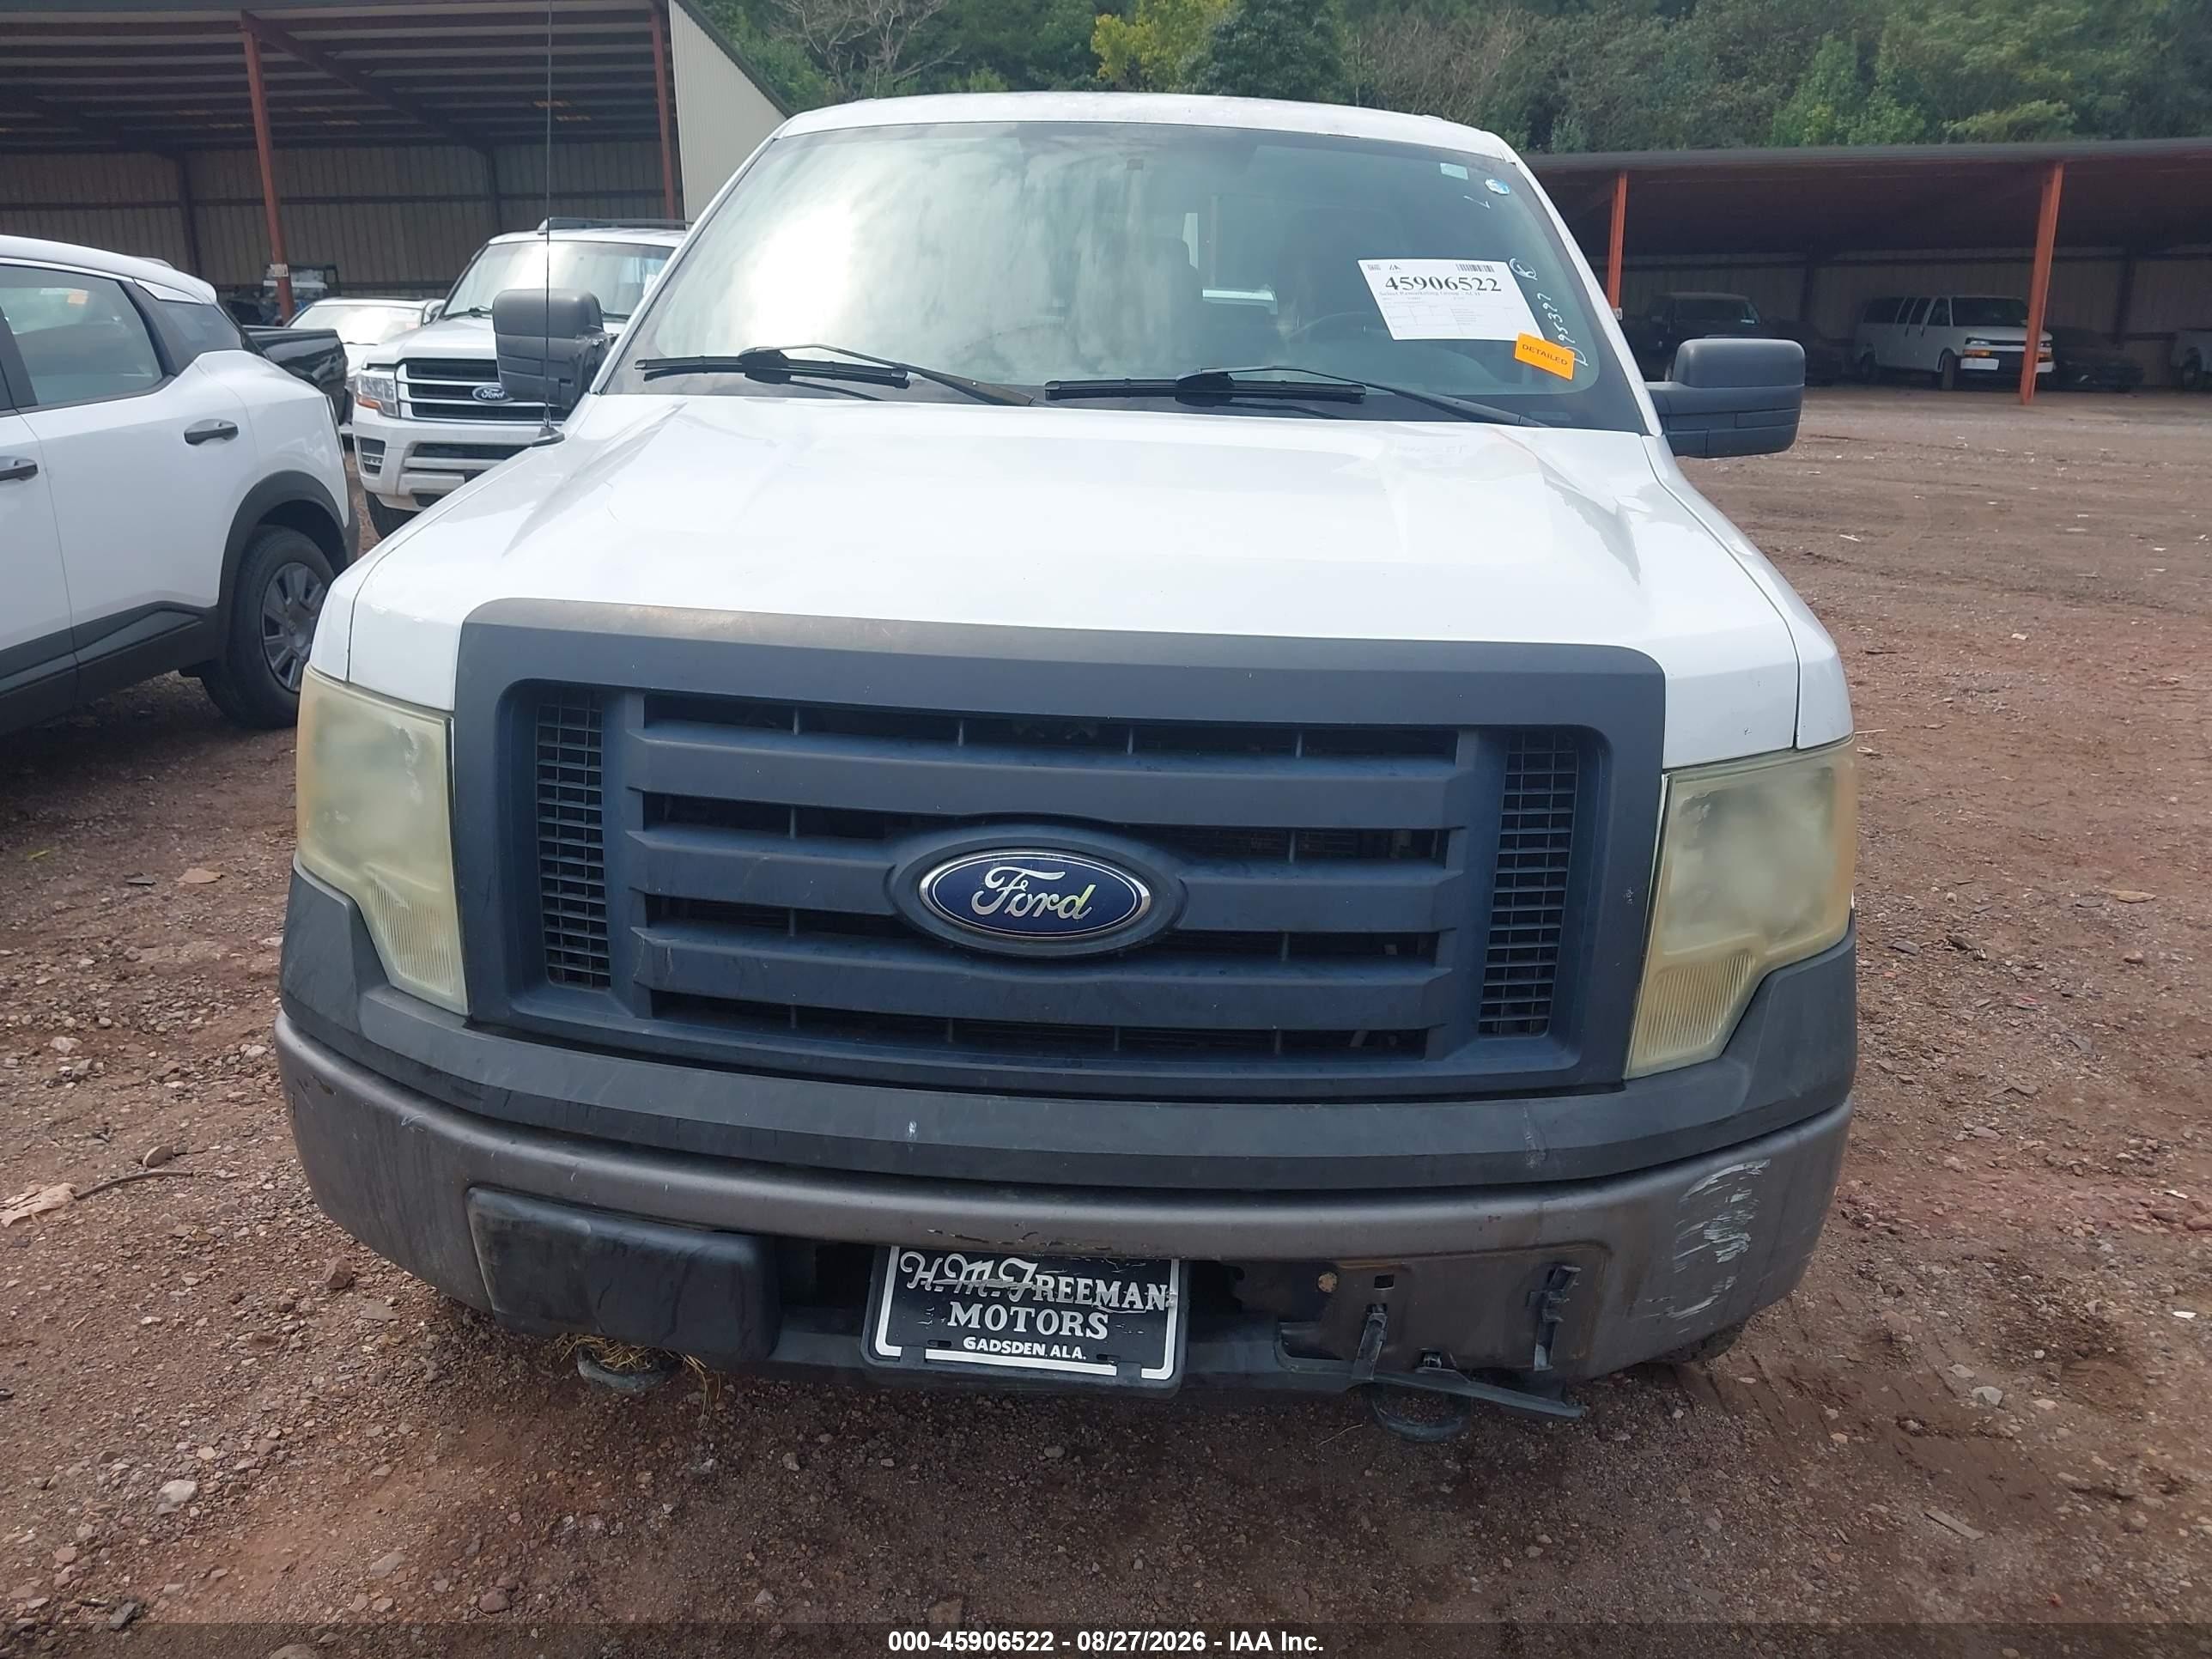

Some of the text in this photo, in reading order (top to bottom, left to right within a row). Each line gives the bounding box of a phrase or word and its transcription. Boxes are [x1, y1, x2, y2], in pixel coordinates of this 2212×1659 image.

[1385, 276, 1502, 292] 45906522
[1522, 343, 1569, 366] DETAILED
[481, 387, 505, 398] Ford
[971, 866, 1097, 920] Ford
[946, 1301, 1109, 1340] MOTORS
[1048, 1343, 1087, 1360] ALA.
